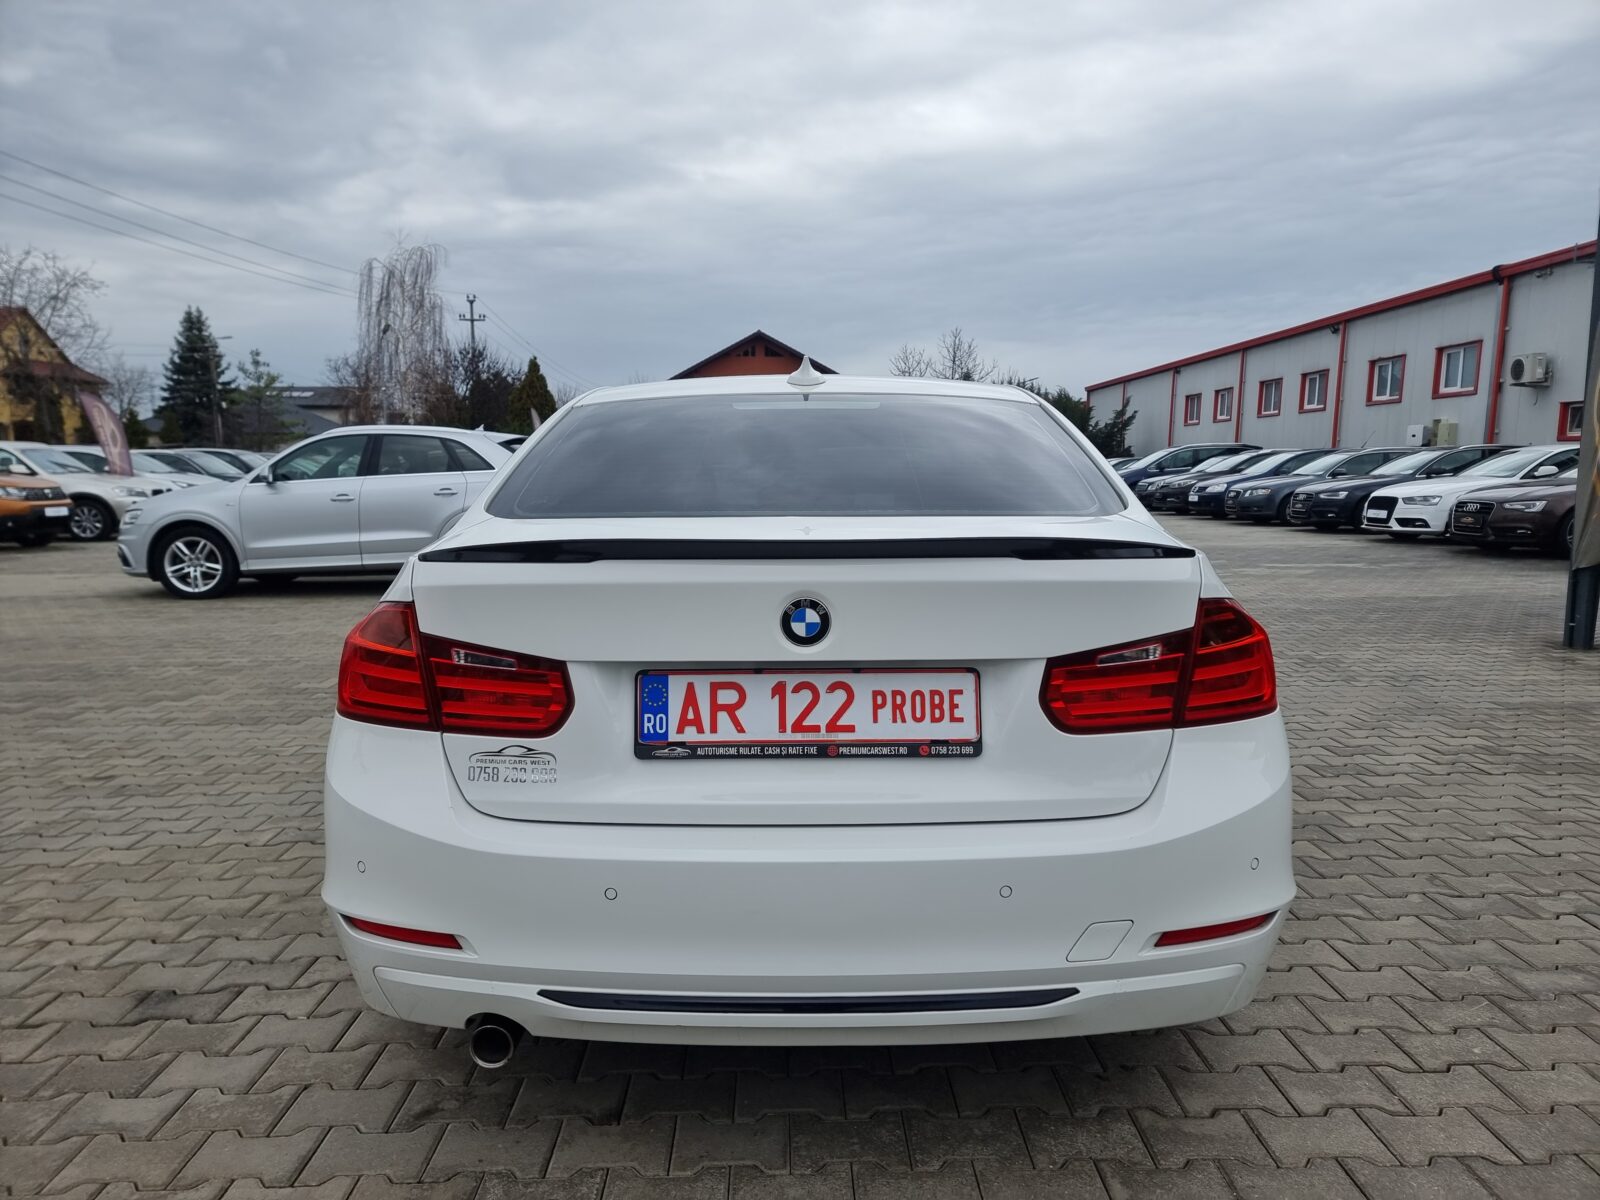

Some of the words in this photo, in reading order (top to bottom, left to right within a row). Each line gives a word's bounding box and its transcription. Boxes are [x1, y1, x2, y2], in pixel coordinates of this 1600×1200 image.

[675, 681, 747, 734] AR
[770, 680, 856, 733] 122
[871, 689, 965, 723] PROBE
[643, 714, 667, 734] RO
[697, 747, 738, 755] AUTOTURISME
[764, 747, 779, 755] CASH
[788, 747, 802, 755] RATE
[804, 746, 817, 755] FIXE
[838, 746, 908, 755] PREMIUMCARSWEST.RO
[931, 746, 947, 754] 0758
[948, 746, 961, 754] 233
[468, 765, 499, 782] 0758
